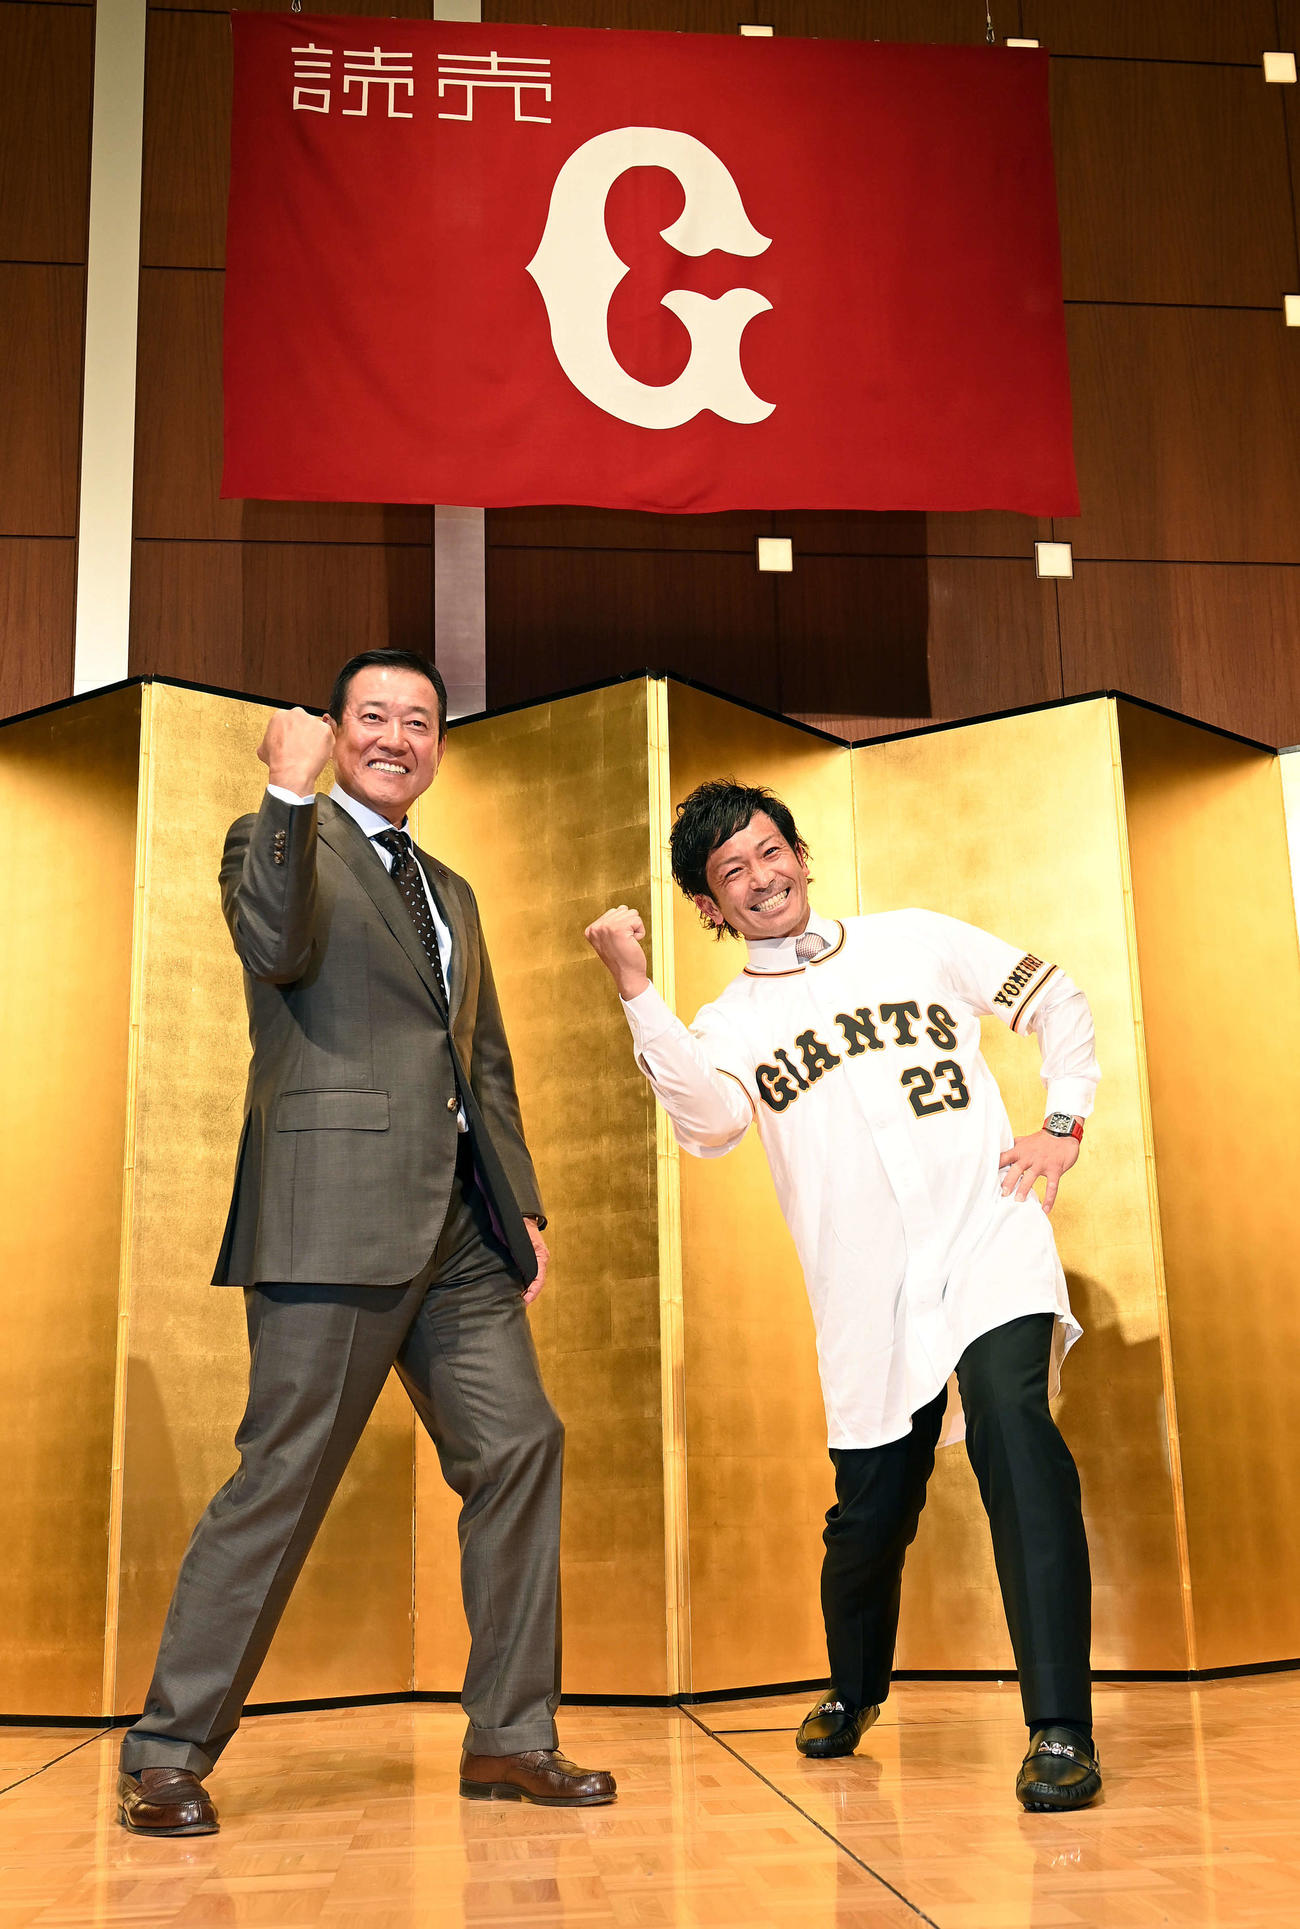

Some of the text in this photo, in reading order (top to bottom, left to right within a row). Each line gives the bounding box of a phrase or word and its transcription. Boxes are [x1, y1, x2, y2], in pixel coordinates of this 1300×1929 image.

[291, 43, 552, 124] 読売
[525, 126, 777, 430] G
[992, 953, 1045, 1008] YOMIURI
[755, 1000, 958, 1113] GIANTS
[900, 1059, 971, 1119] 23
